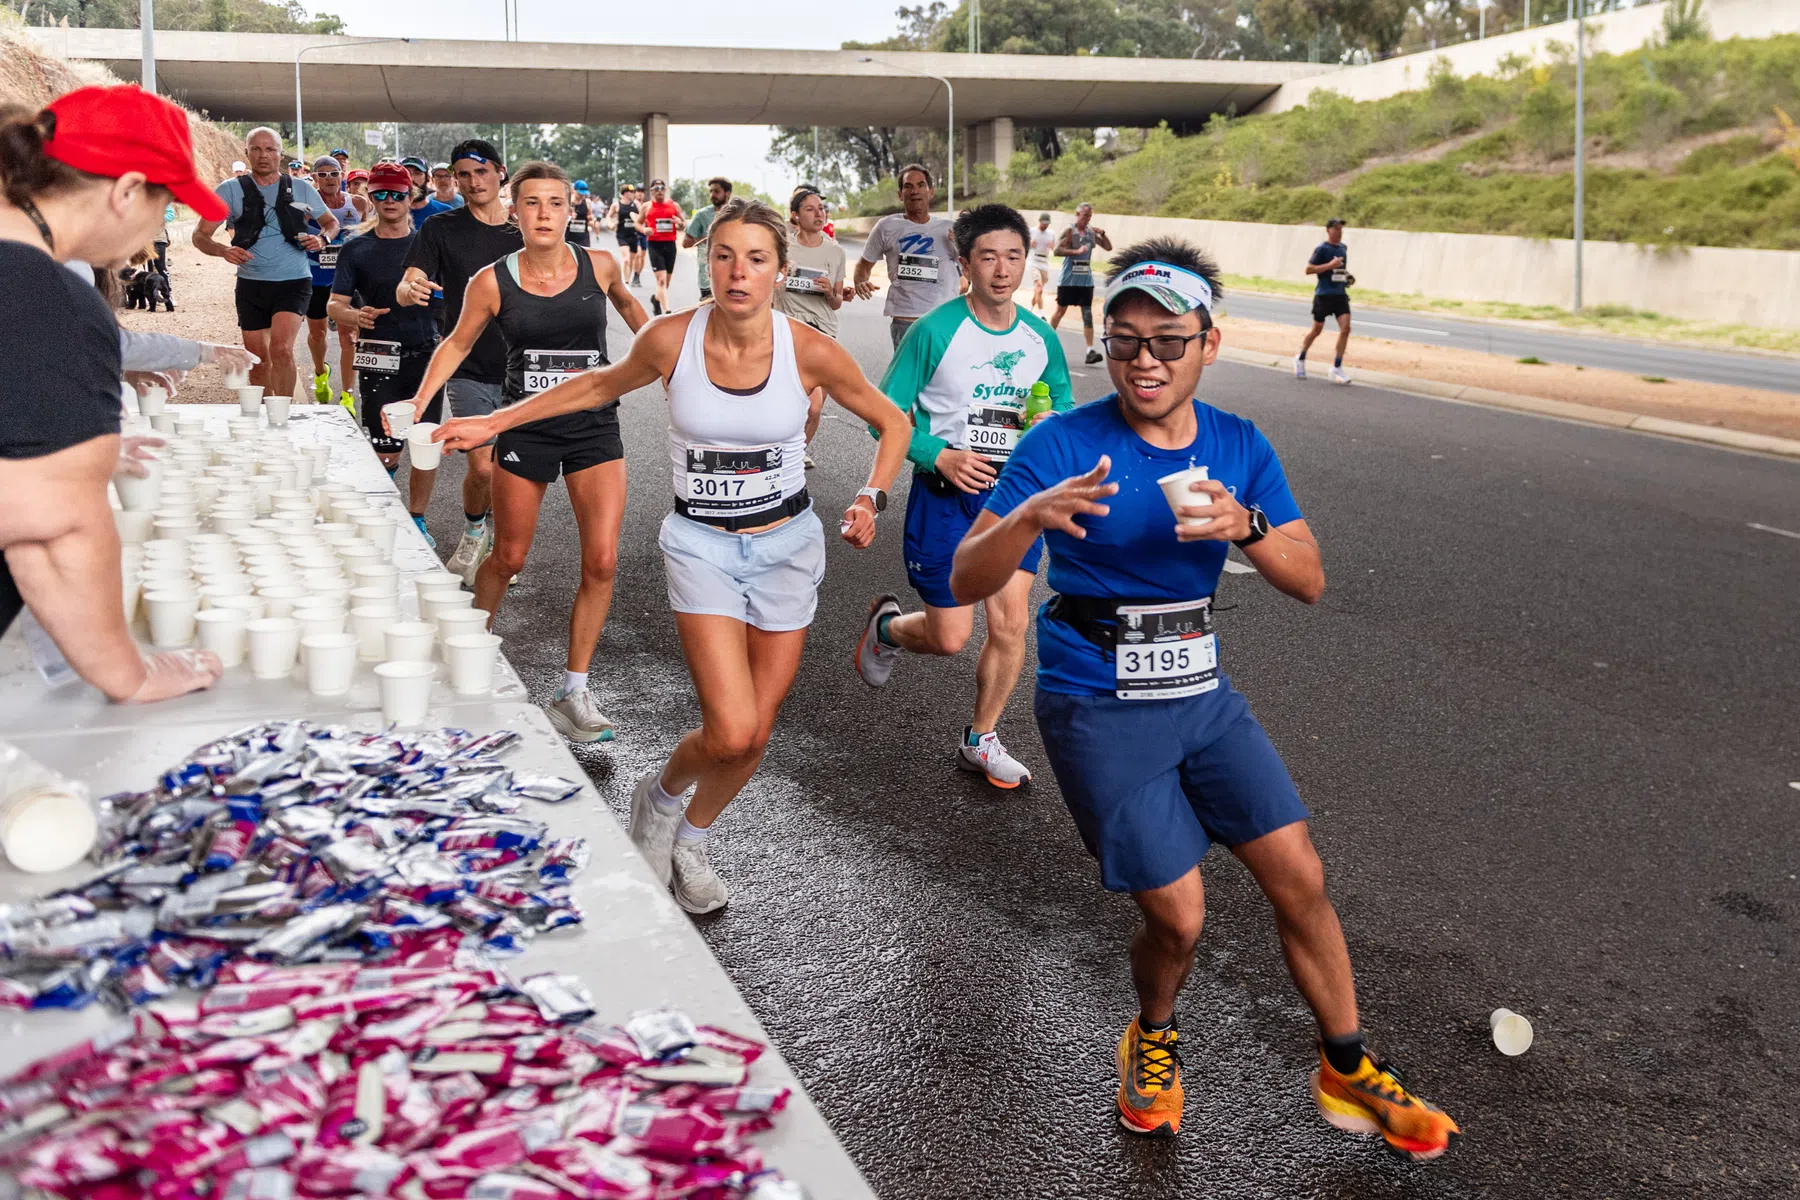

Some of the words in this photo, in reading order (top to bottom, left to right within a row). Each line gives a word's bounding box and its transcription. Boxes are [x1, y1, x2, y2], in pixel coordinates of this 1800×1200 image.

[321, 255, 338, 263] 258
[899, 266, 922, 277] 2352
[1122, 265, 1171, 282] IRONMAN
[787, 278, 811, 289] 2353
[355, 355, 378, 366] 2590
[972, 381, 1032, 400] Sydney
[969, 429, 1007, 446] 3008
[692, 478, 746, 497] 3017
[769, 483, 776, 491] A
[1124, 648, 1191, 673] 3195
